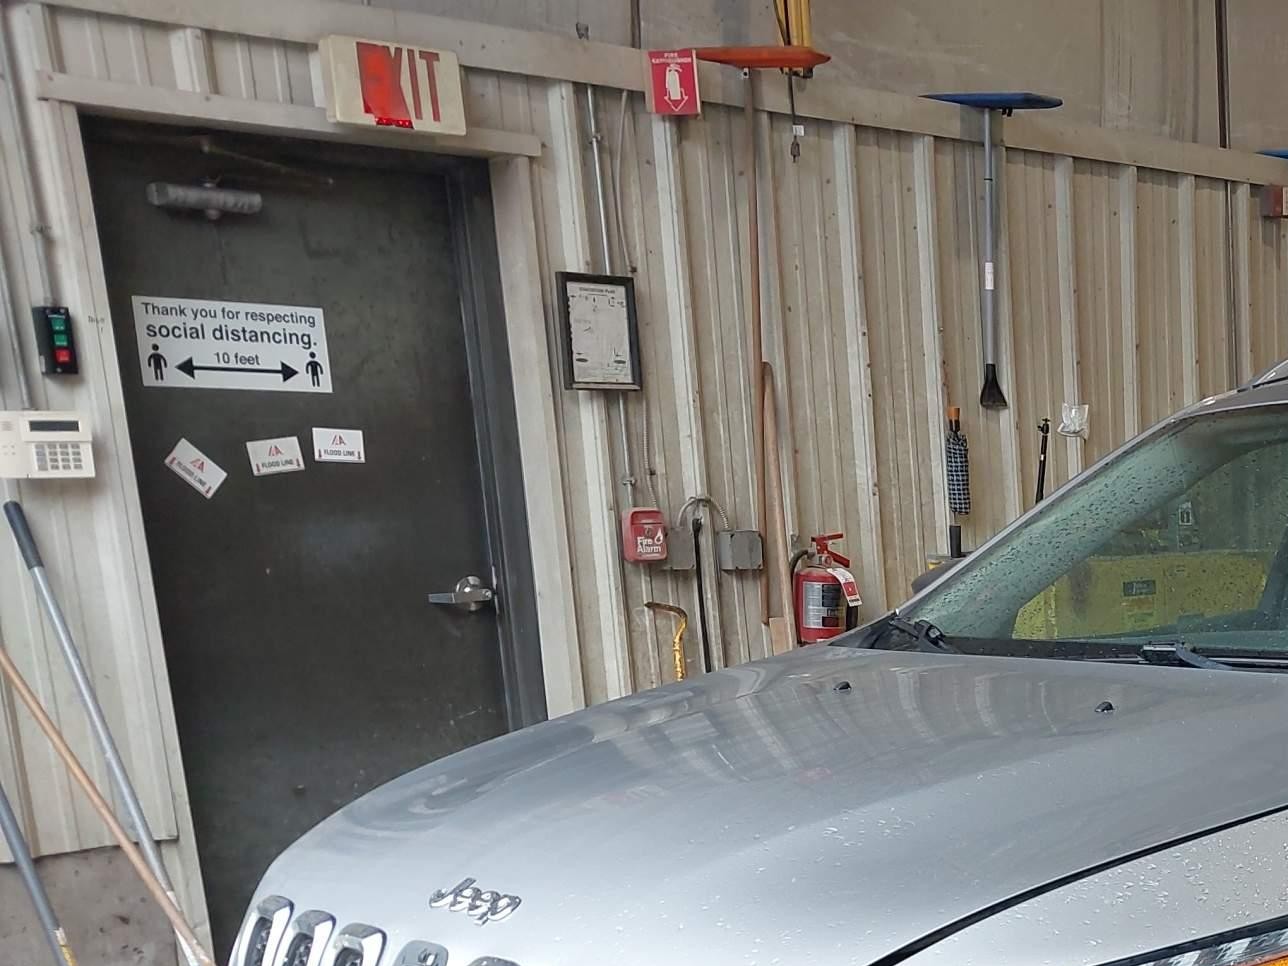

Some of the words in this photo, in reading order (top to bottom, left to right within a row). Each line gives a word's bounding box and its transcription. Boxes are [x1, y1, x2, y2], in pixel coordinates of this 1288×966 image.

[141, 302, 188, 318] Thank
[191, 307, 217, 321] you
[220, 307, 241, 320] for
[244, 311, 316, 328] respecting
[146, 322, 206, 340] social
[212, 324, 318, 350] distancing.
[214, 352, 231, 365] 10
[234, 352, 261, 366] feet
[637, 536, 653, 545] Fire
[637, 544, 662, 553] Alarm
[429, 877, 522, 926] Jeep
